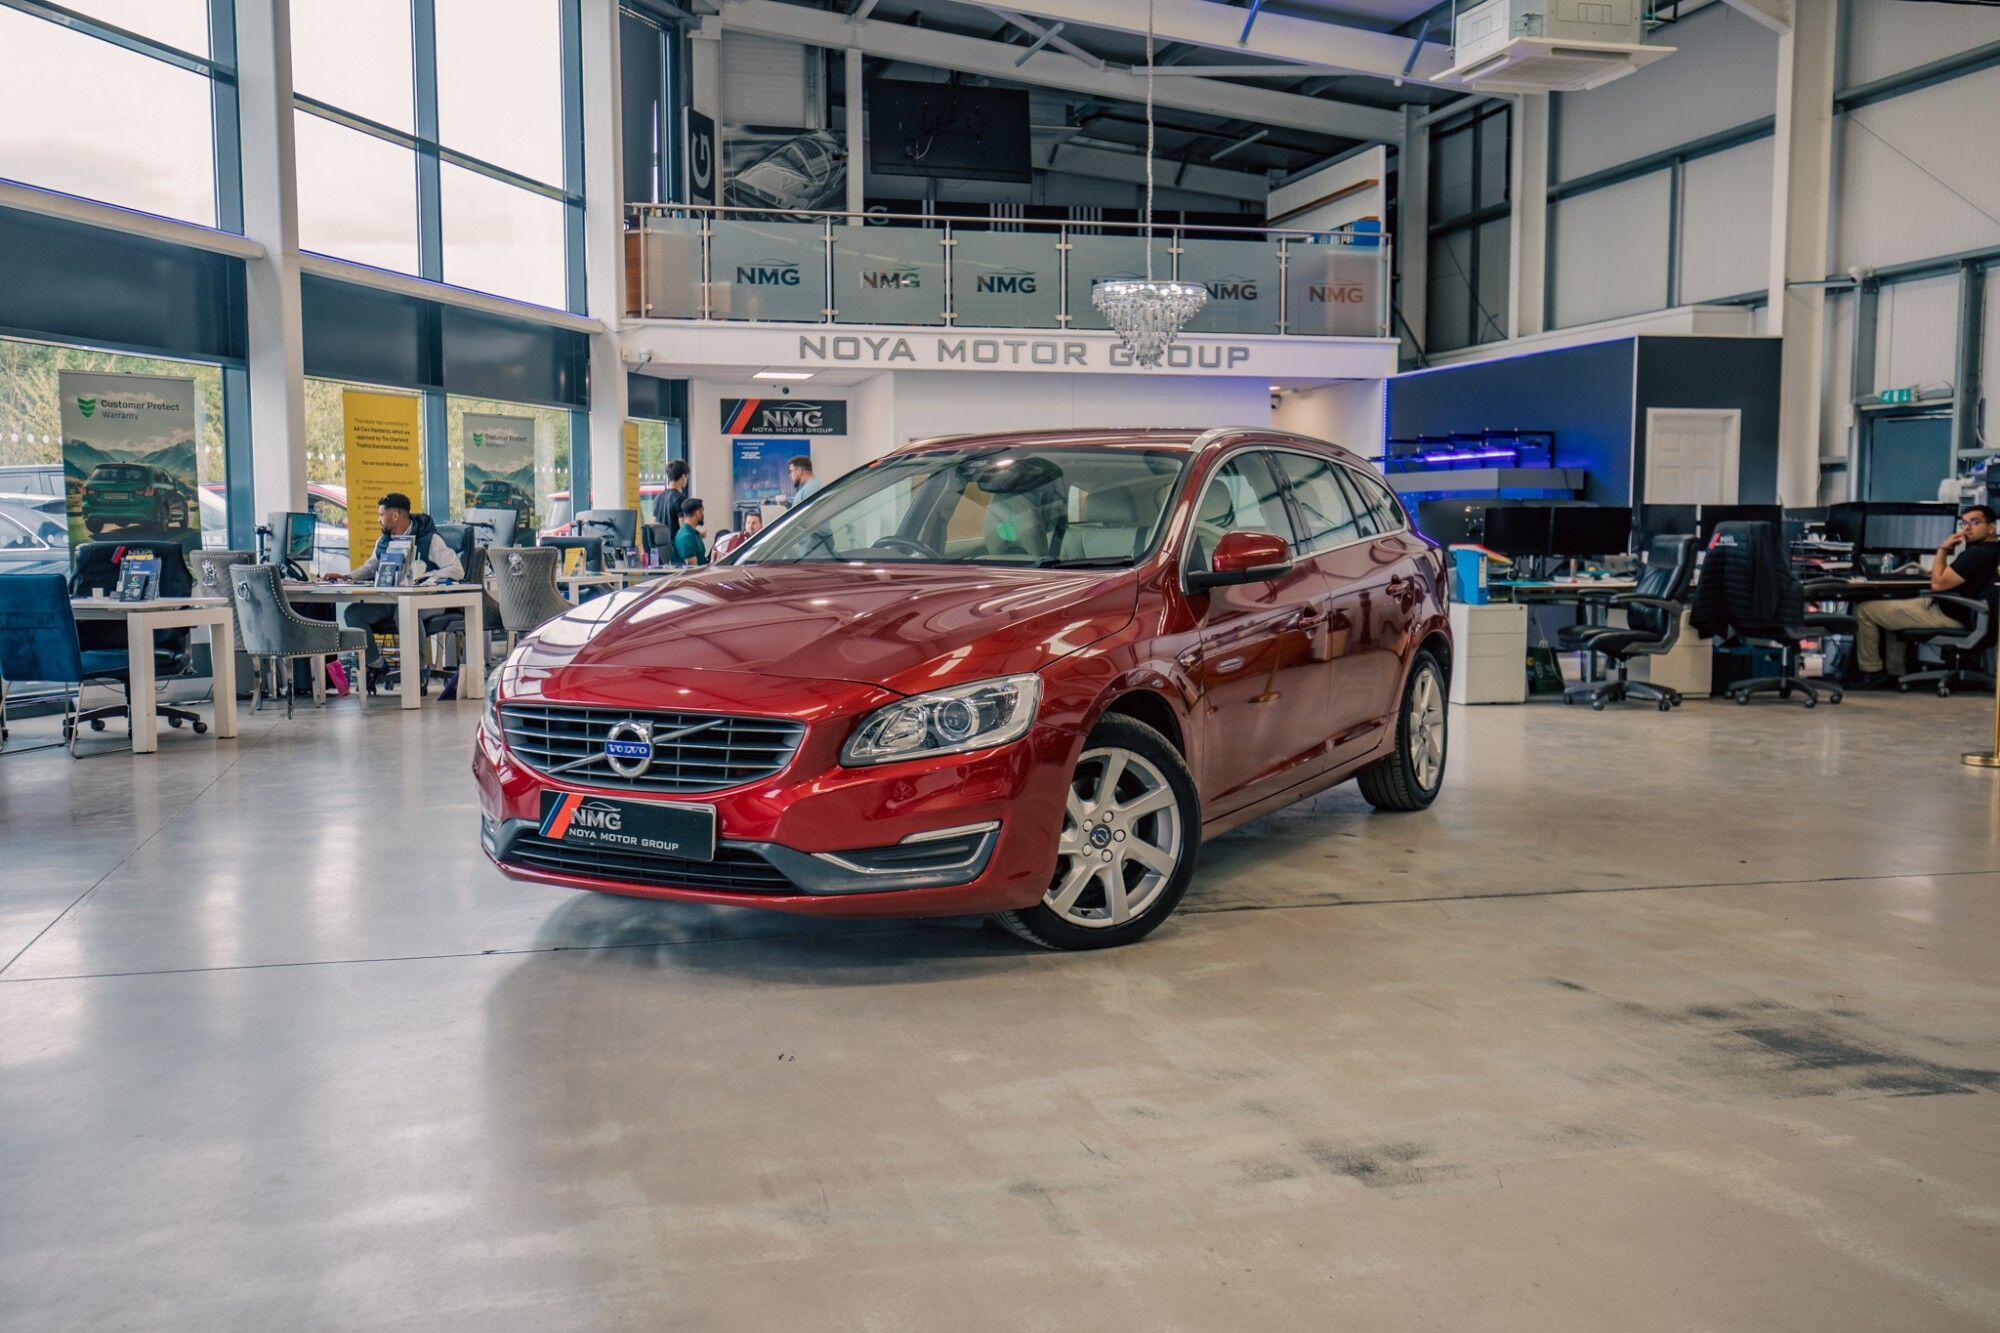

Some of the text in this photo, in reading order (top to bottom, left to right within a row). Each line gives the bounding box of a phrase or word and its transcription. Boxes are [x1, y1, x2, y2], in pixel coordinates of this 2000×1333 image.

[737, 267, 800, 285] NMG
[863, 271, 920, 288] NMG
[977, 275, 1036, 293] NMG
[1206, 283, 1257, 300] NMG
[1309, 286, 1364, 303] NMG
[799, 335, 916, 362] NOYA
[937, 339, 1087, 365] MOTOR
[101, 400, 180, 411] Customer Protect
[102, 411, 138, 420] Warranty
[762, 410, 824, 428] NMG
[608, 744, 647, 754] VOLVO
[571, 808, 621, 830] NMG
[569, 828, 679, 851] NOYA MOTOR GROUP
